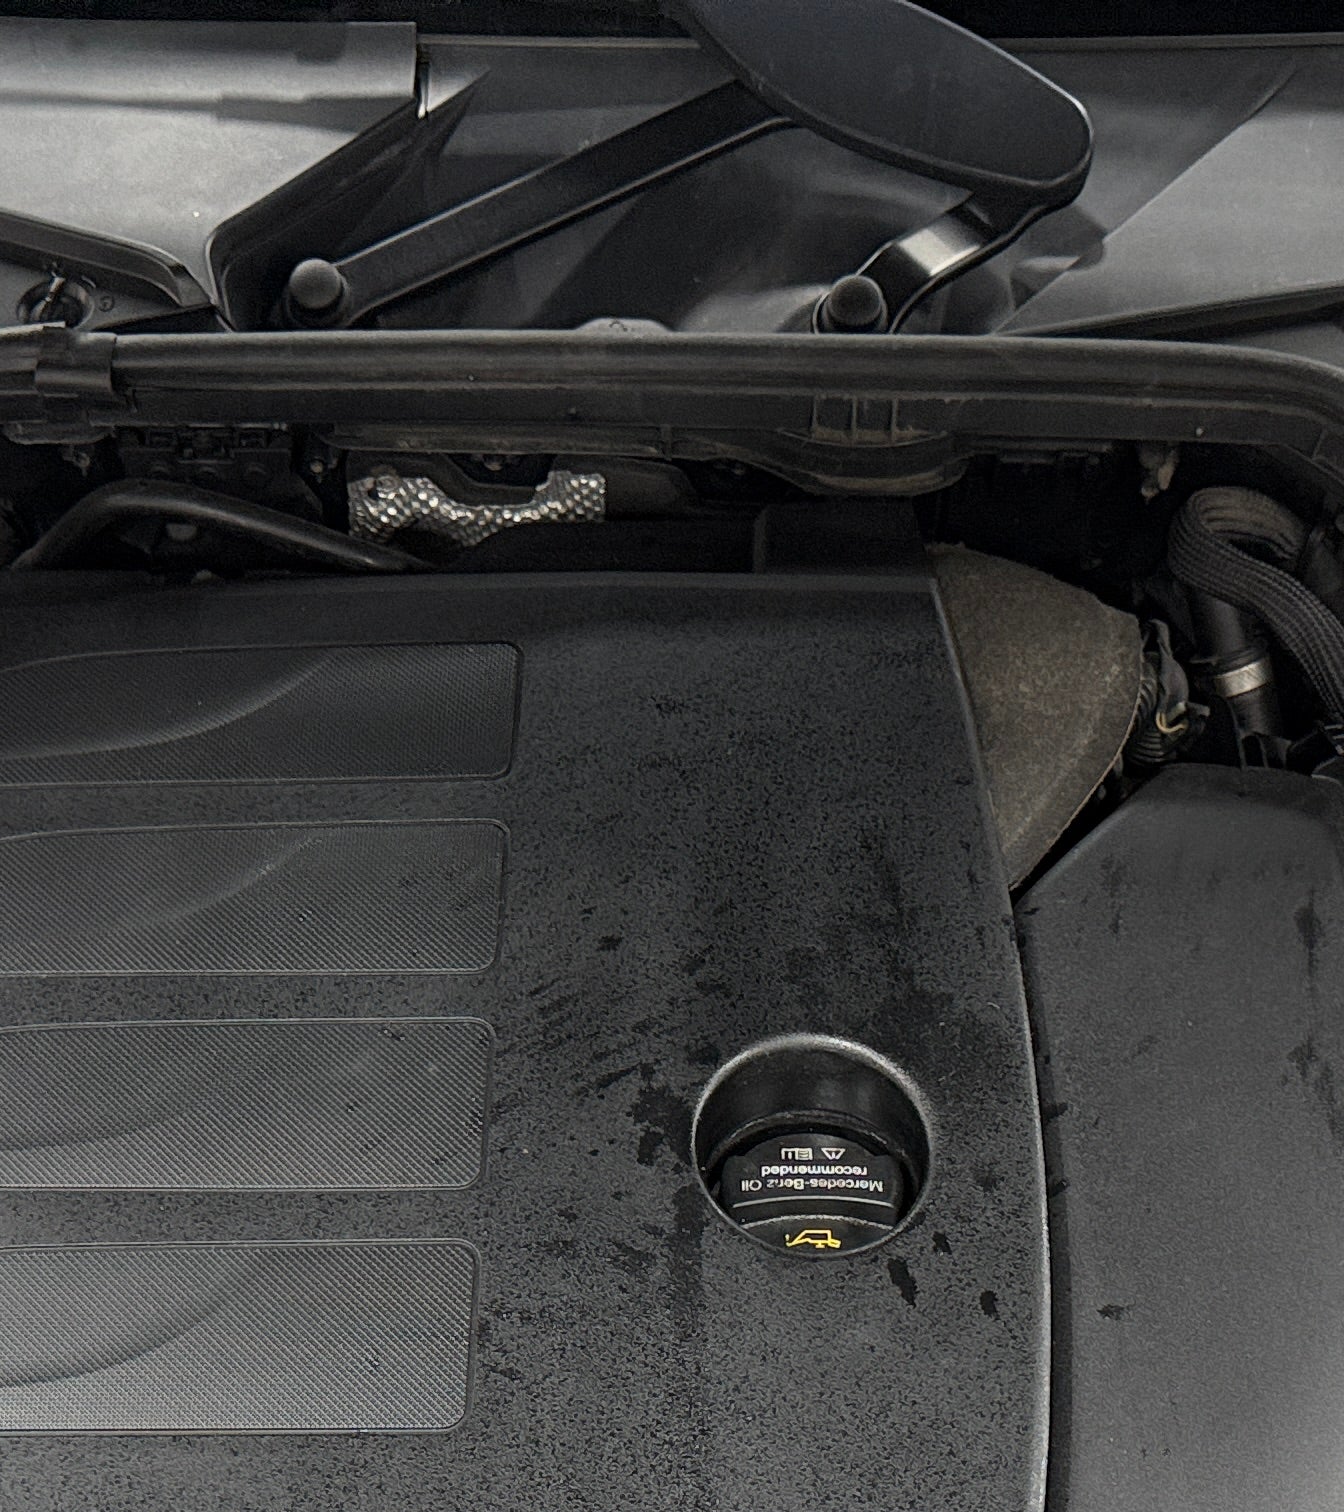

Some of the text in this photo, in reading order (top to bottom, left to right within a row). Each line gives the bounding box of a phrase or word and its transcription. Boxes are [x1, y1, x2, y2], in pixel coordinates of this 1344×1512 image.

[761, 1165, 867, 1177] recommended
[741, 1178, 884, 1193] Mercedes-Benz Oil
